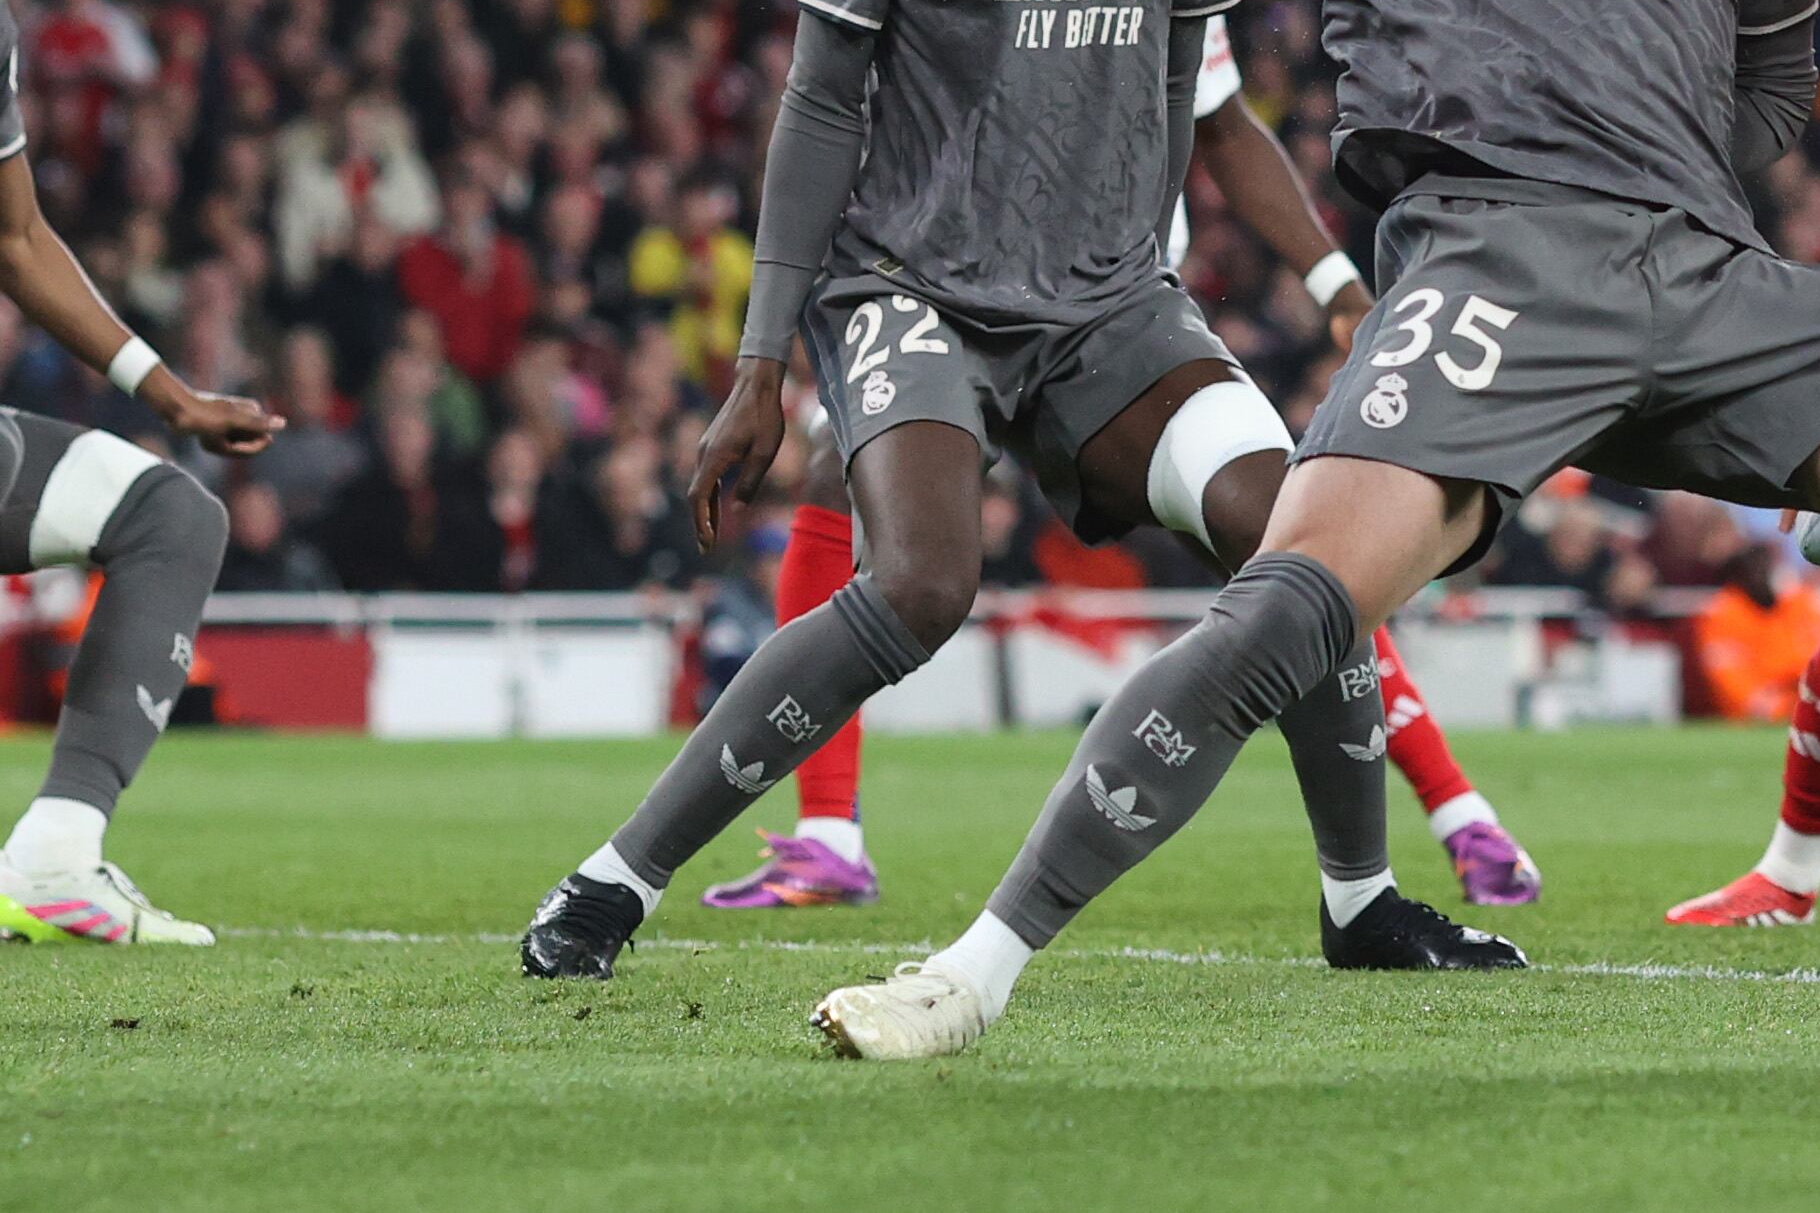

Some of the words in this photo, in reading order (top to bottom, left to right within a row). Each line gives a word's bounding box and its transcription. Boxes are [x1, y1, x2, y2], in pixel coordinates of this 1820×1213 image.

[1015, 9, 1057, 49] FLY
[845, 294, 949, 385] 22
[1370, 288, 1520, 390] 35
